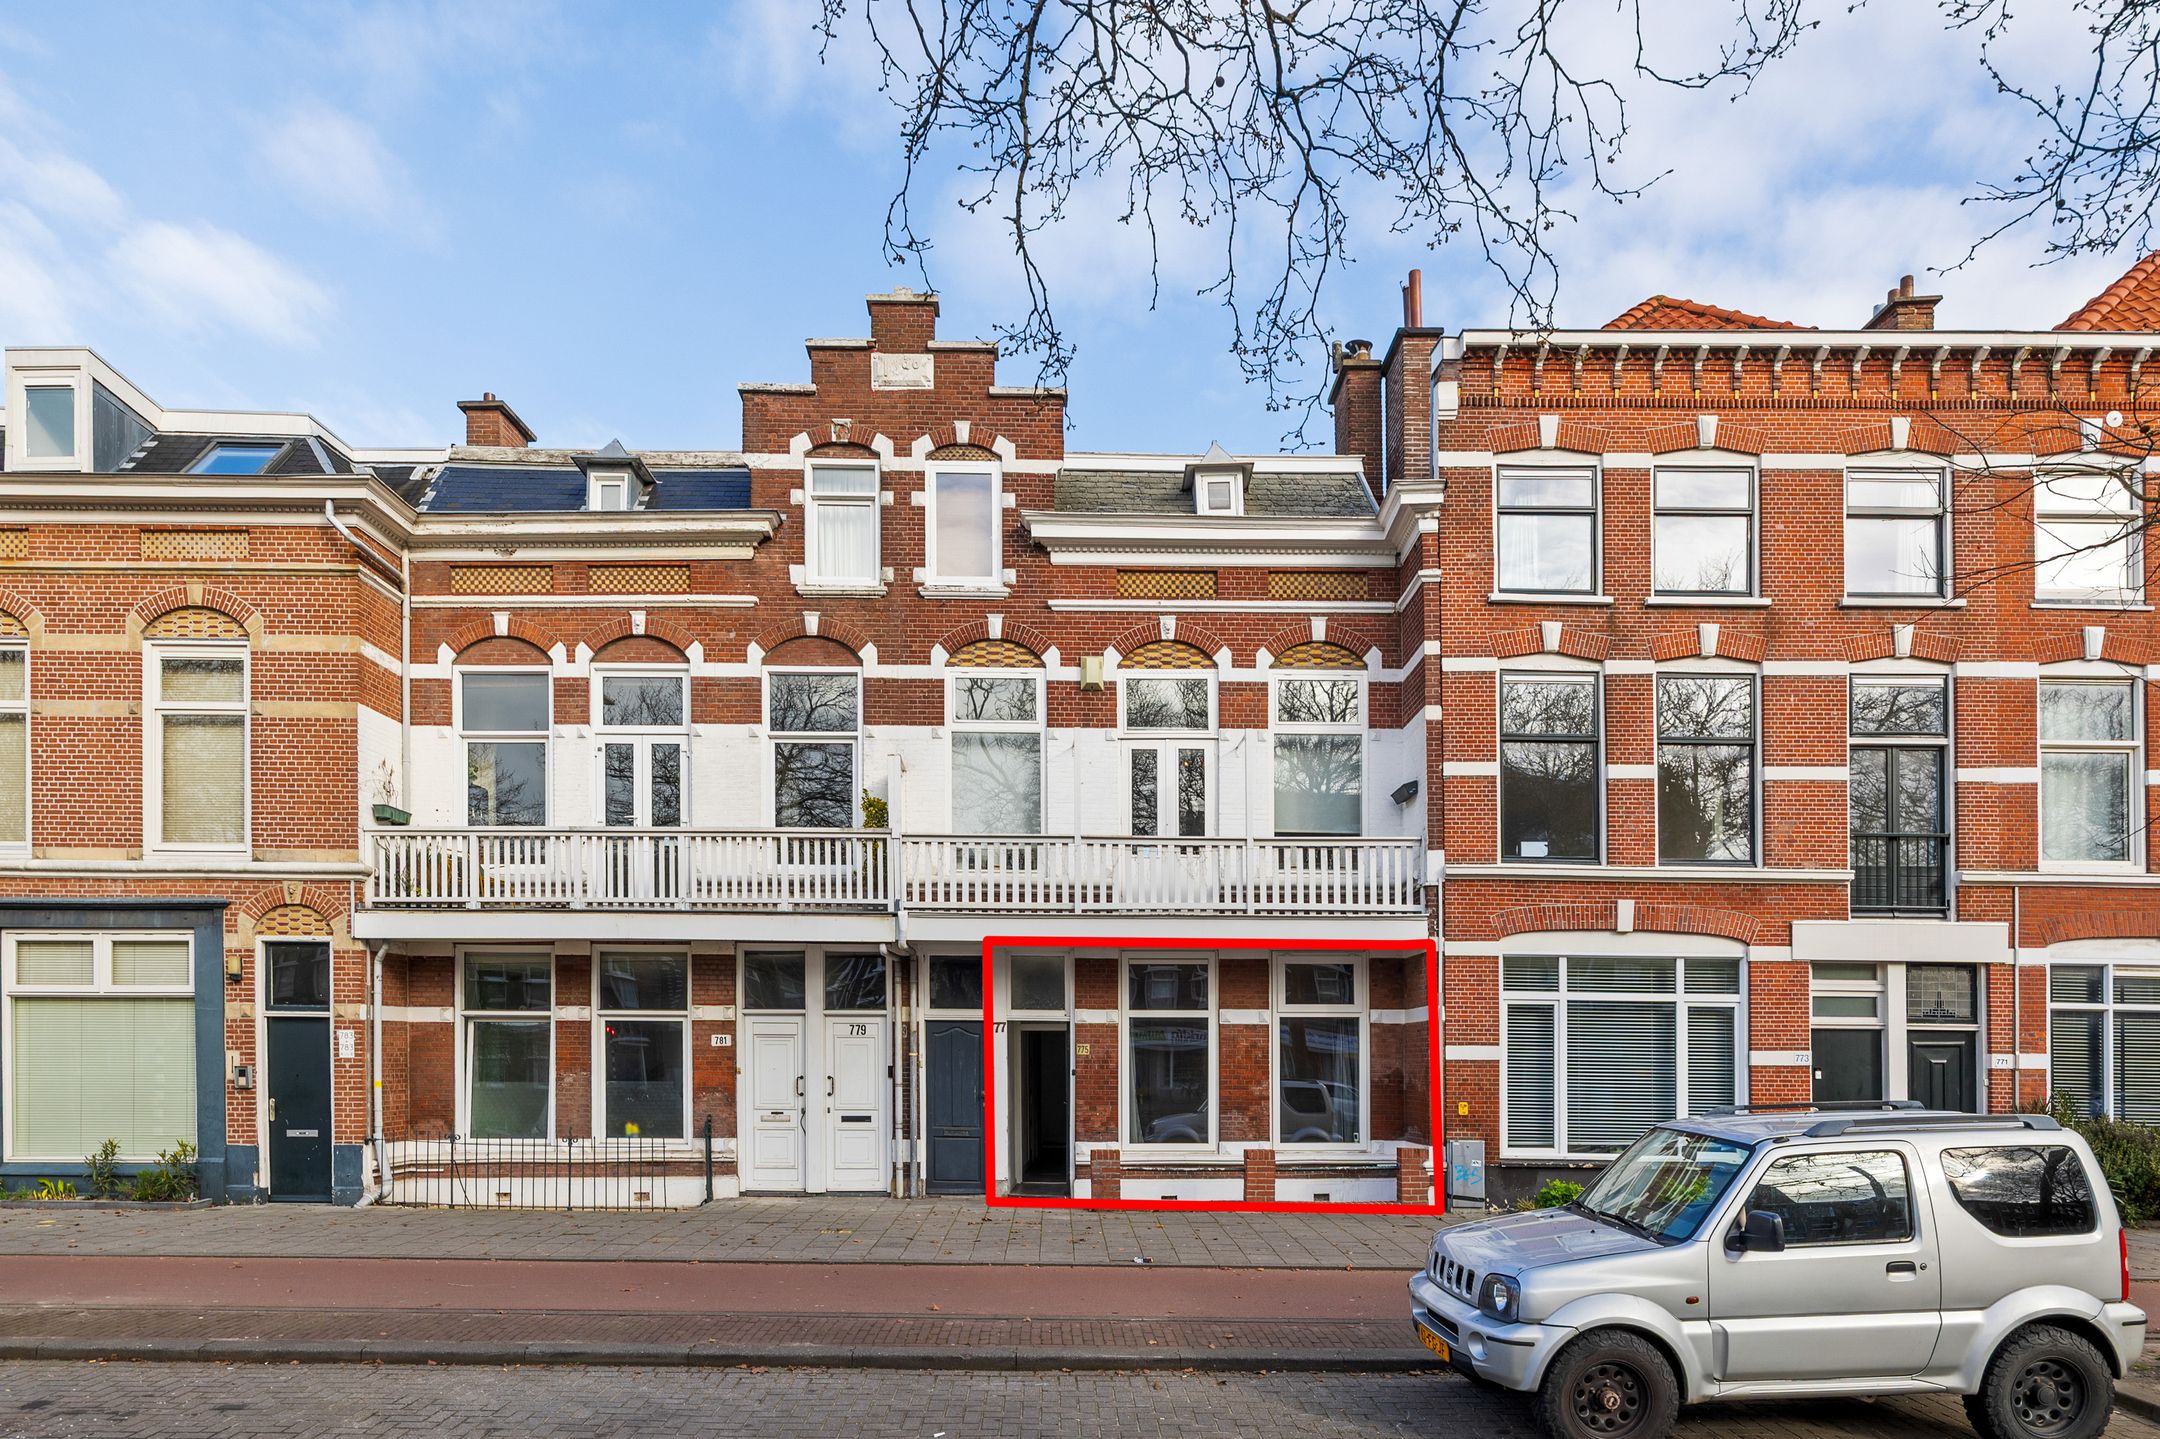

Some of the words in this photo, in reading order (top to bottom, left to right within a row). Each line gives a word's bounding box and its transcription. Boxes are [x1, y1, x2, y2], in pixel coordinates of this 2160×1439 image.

[849, 1024, 867, 1036] 779
[340, 1031, 354, 1039] 783
[714, 1036, 727, 1045] 781
[340, 1043, 354, 1051] 783
[1077, 1045, 1089, 1054] 775
[1795, 1054, 1810, 1063] 773
